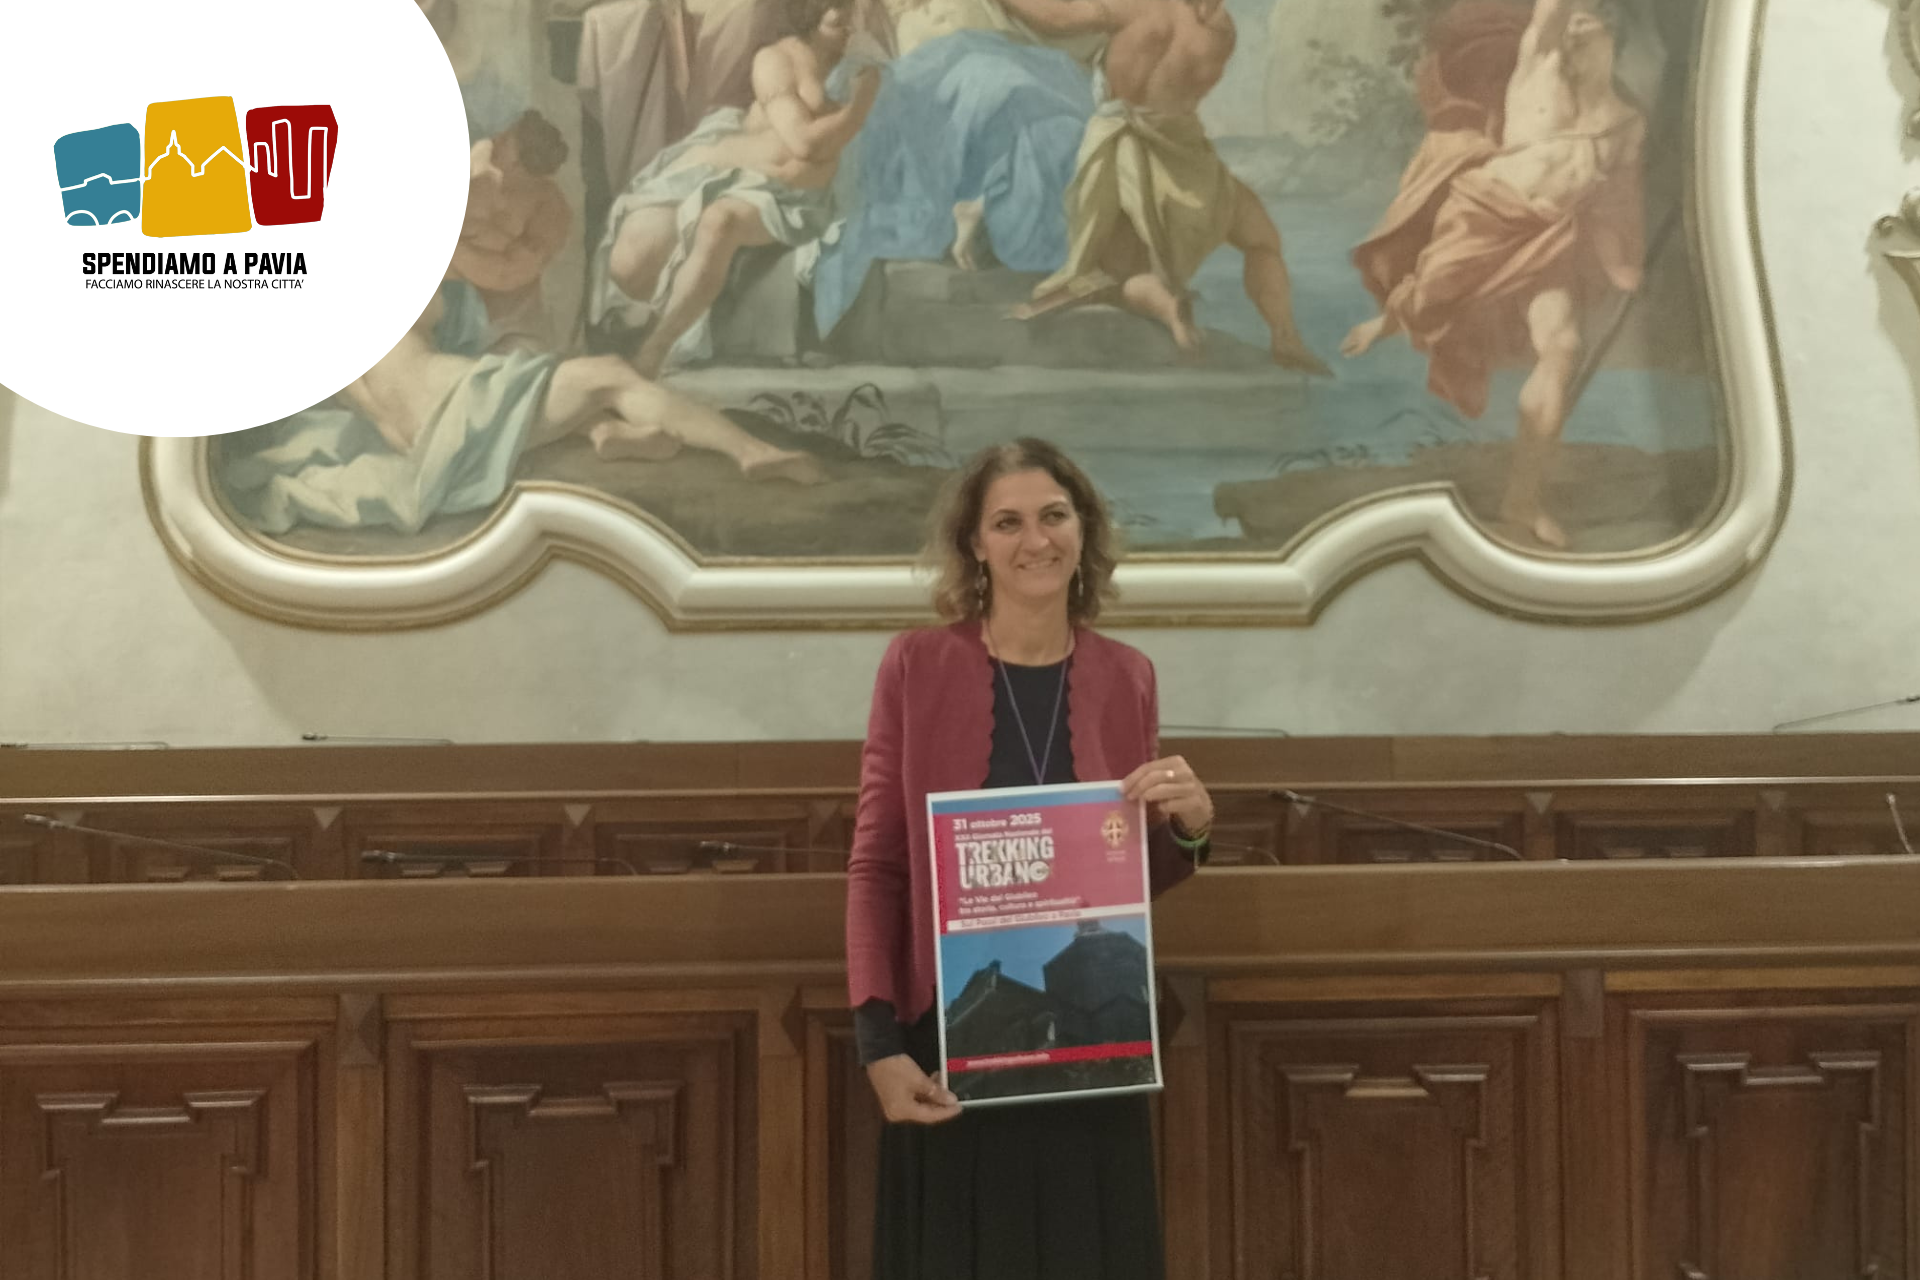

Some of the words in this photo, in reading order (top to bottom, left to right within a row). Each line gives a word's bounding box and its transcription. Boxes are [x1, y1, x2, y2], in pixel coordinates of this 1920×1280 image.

[952, 818, 967, 831] 31
[970, 818, 1007, 829] ottobre
[1009, 812, 1042, 826] 2025
[955, 835, 1054, 866] TREKKING
[959, 860, 1050, 890] URBANO
[974, 895, 989, 904] Vie
